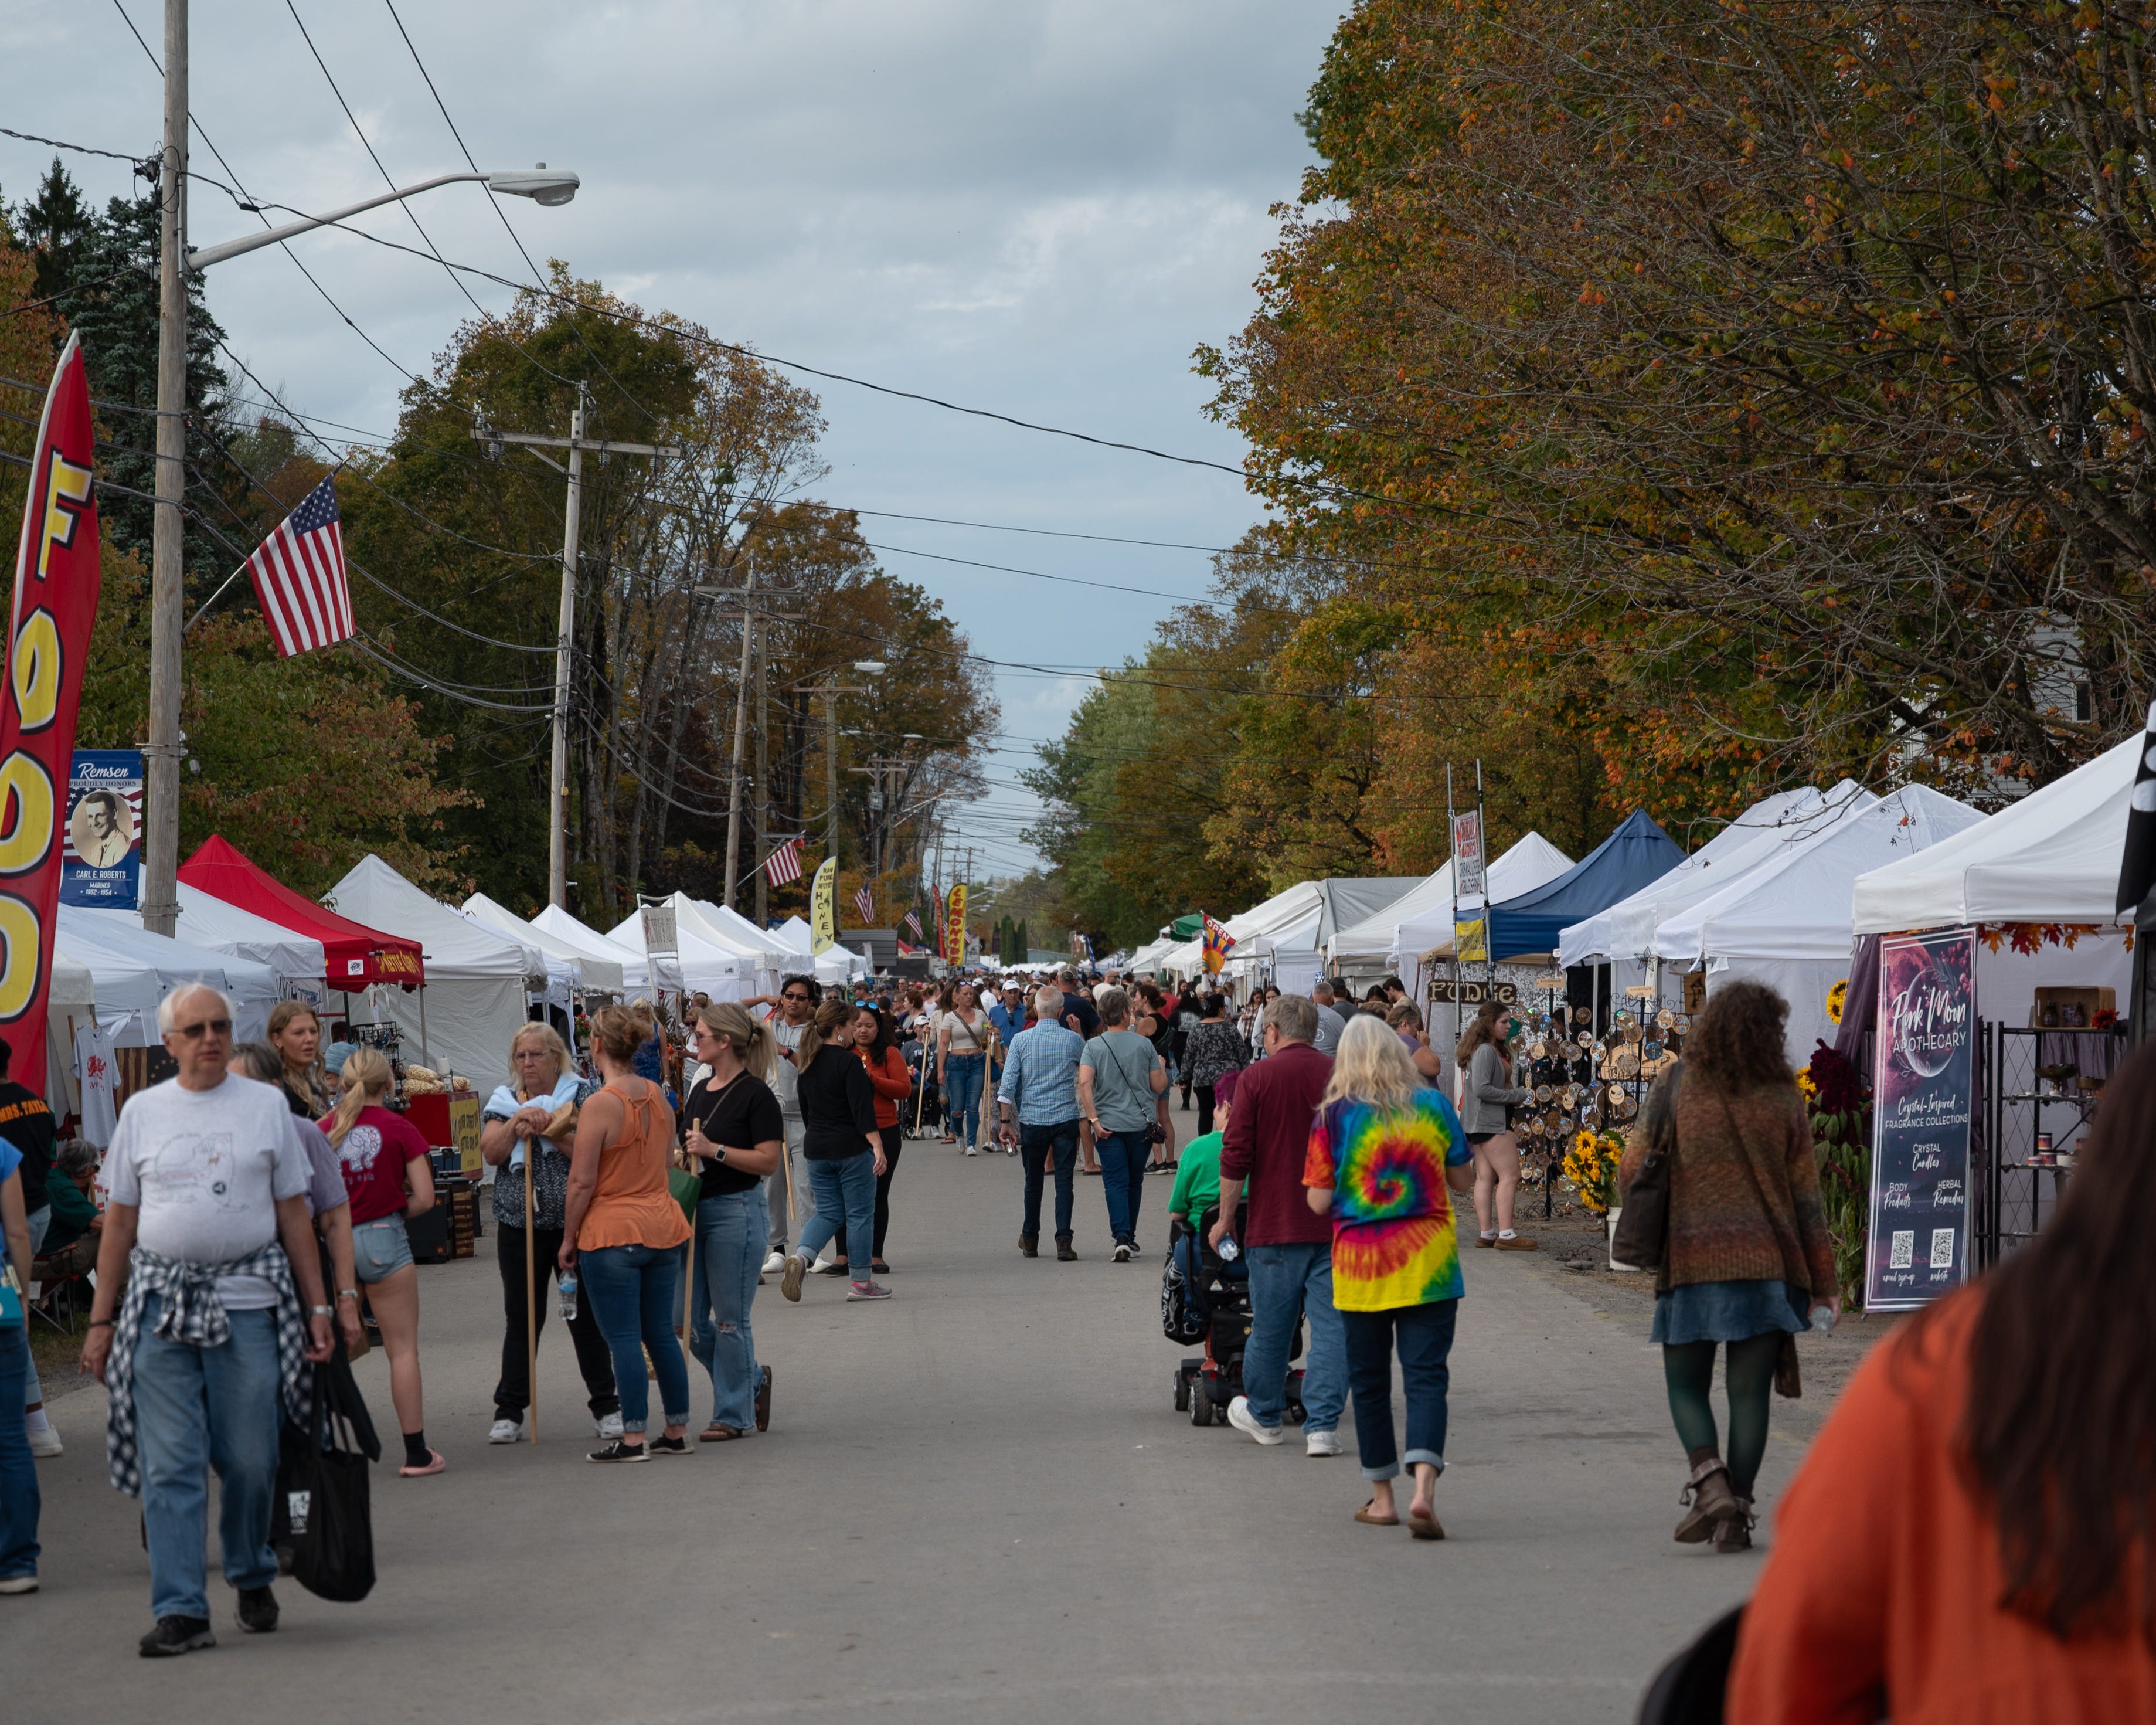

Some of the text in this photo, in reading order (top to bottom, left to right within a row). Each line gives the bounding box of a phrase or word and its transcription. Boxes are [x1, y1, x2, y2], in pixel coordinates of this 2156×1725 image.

[0, 444, 94, 1024] FOOD
[78, 762, 129, 780] Remsen
[76, 870, 126, 880] CARL E. ROBERTS
[815, 892, 833, 941] HONEY
[949, 888, 963, 965] LEMONADE
[1206, 919, 1230, 942] OPEN
[1891, 986, 1966, 1037] Pink Moon
[1893, 1031, 1967, 1054] APOTHECARY
[1898, 1094, 1956, 1122] Crystal-Inspired
[1885, 1113, 1968, 1129] FRAGRANCE COLLECTIONS
[1913, 1143, 1941, 1154] CRYSTAL
[1912, 1153, 1940, 1172] Candles
[1889, 1182, 1908, 1193] BODY
[1937, 1179, 1962, 1190] HERBAL
[1883, 1193, 1911, 1211] Products
[1933, 1189, 1964, 1208] Remedies
